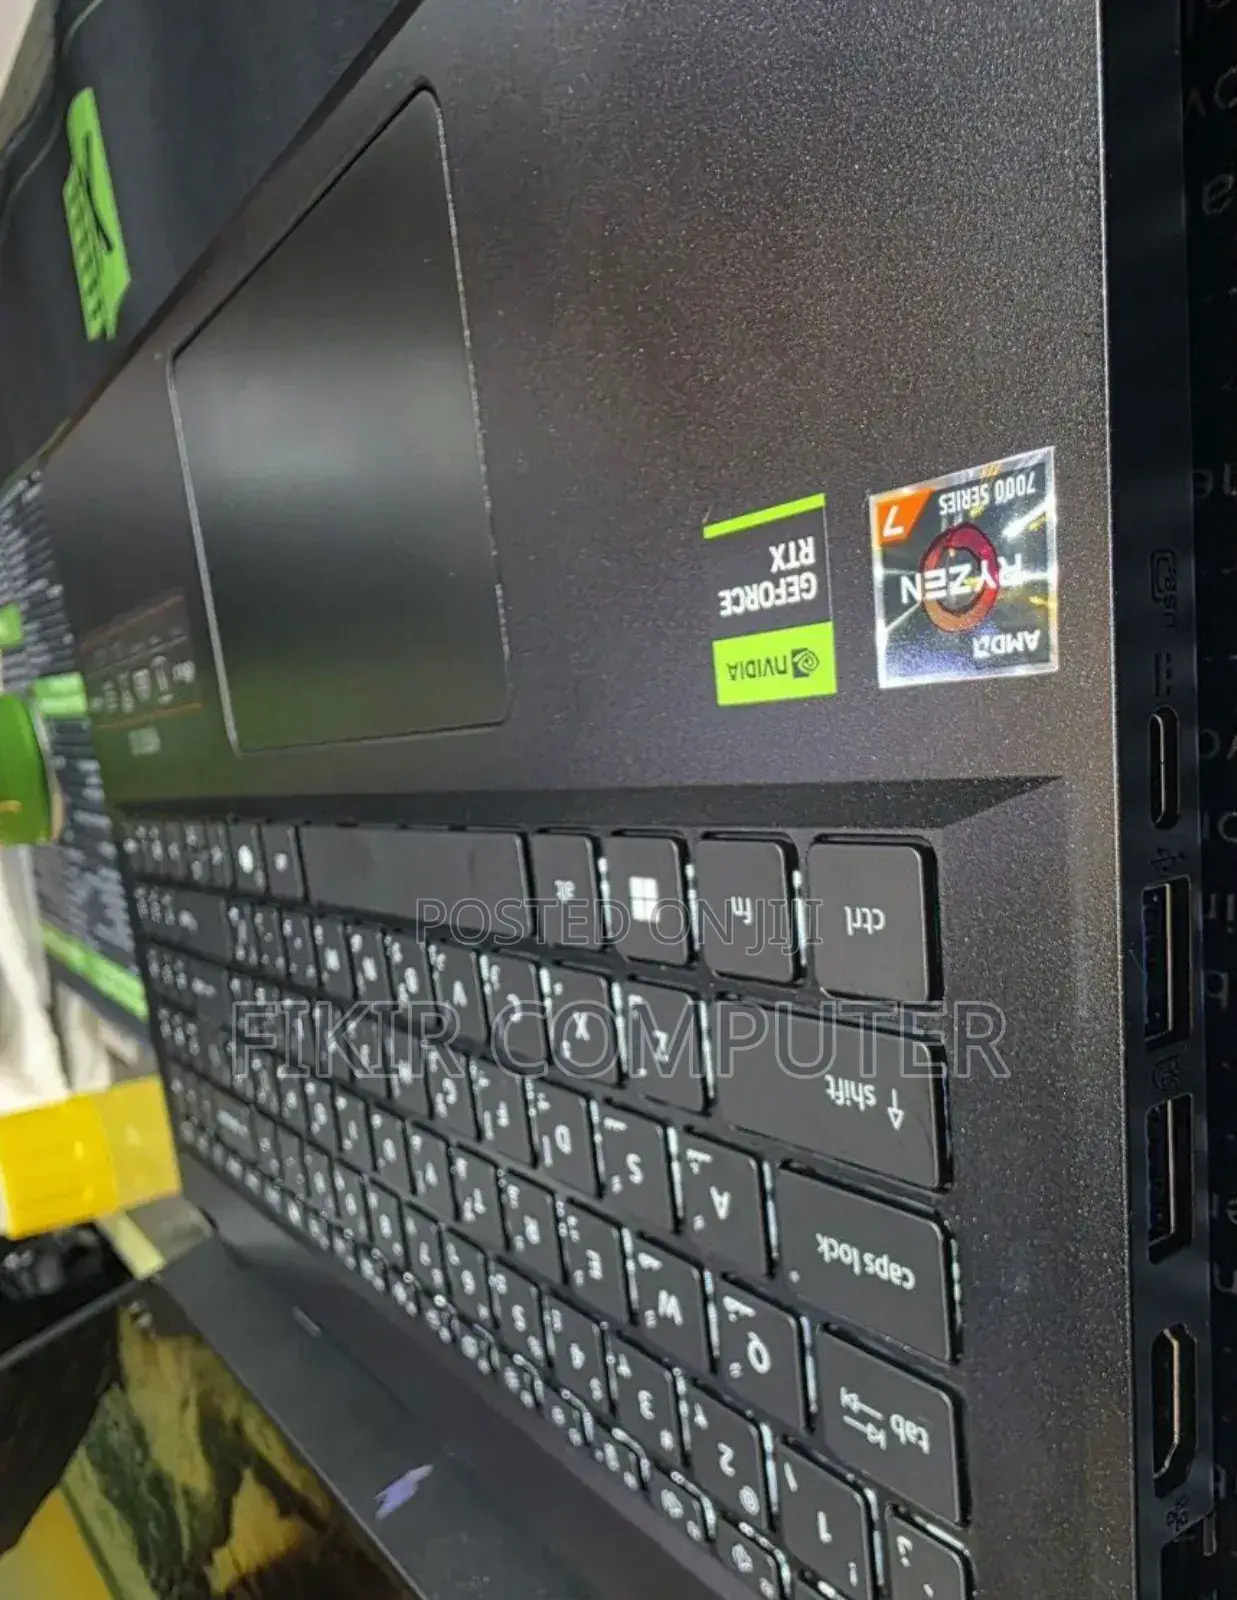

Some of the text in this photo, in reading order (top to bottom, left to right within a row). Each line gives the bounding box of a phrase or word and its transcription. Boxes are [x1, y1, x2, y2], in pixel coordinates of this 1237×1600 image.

[938, 471, 1037, 515] 7000 SERIES
[883, 505, 905, 537] 7
[768, 536, 815, 572] RTX
[718, 571, 818, 617] GEFORCE
[900, 553, 1022, 604] RYZEN
[730, 895, 753, 925] fn
[843, 904, 886, 936] ctrl
[572, 1011, 590, 1041] X
[824, 1074, 877, 1112] shift
[554, 1124, 572, 1155] D
[626, 1152, 644, 1185] S
[709, 1185, 731, 1220] A
[815, 1232, 861, 1276] lock
[861, 1251, 916, 1290] caps
[658, 1290, 684, 1326] W
[747, 1331, 772, 1374] Q
[637, 1389, 656, 1420] 3
[889, 1412, 931, 1454] tab
[717, 1441, 736, 1478] 2
[816, 1510, 833, 1545] 1
